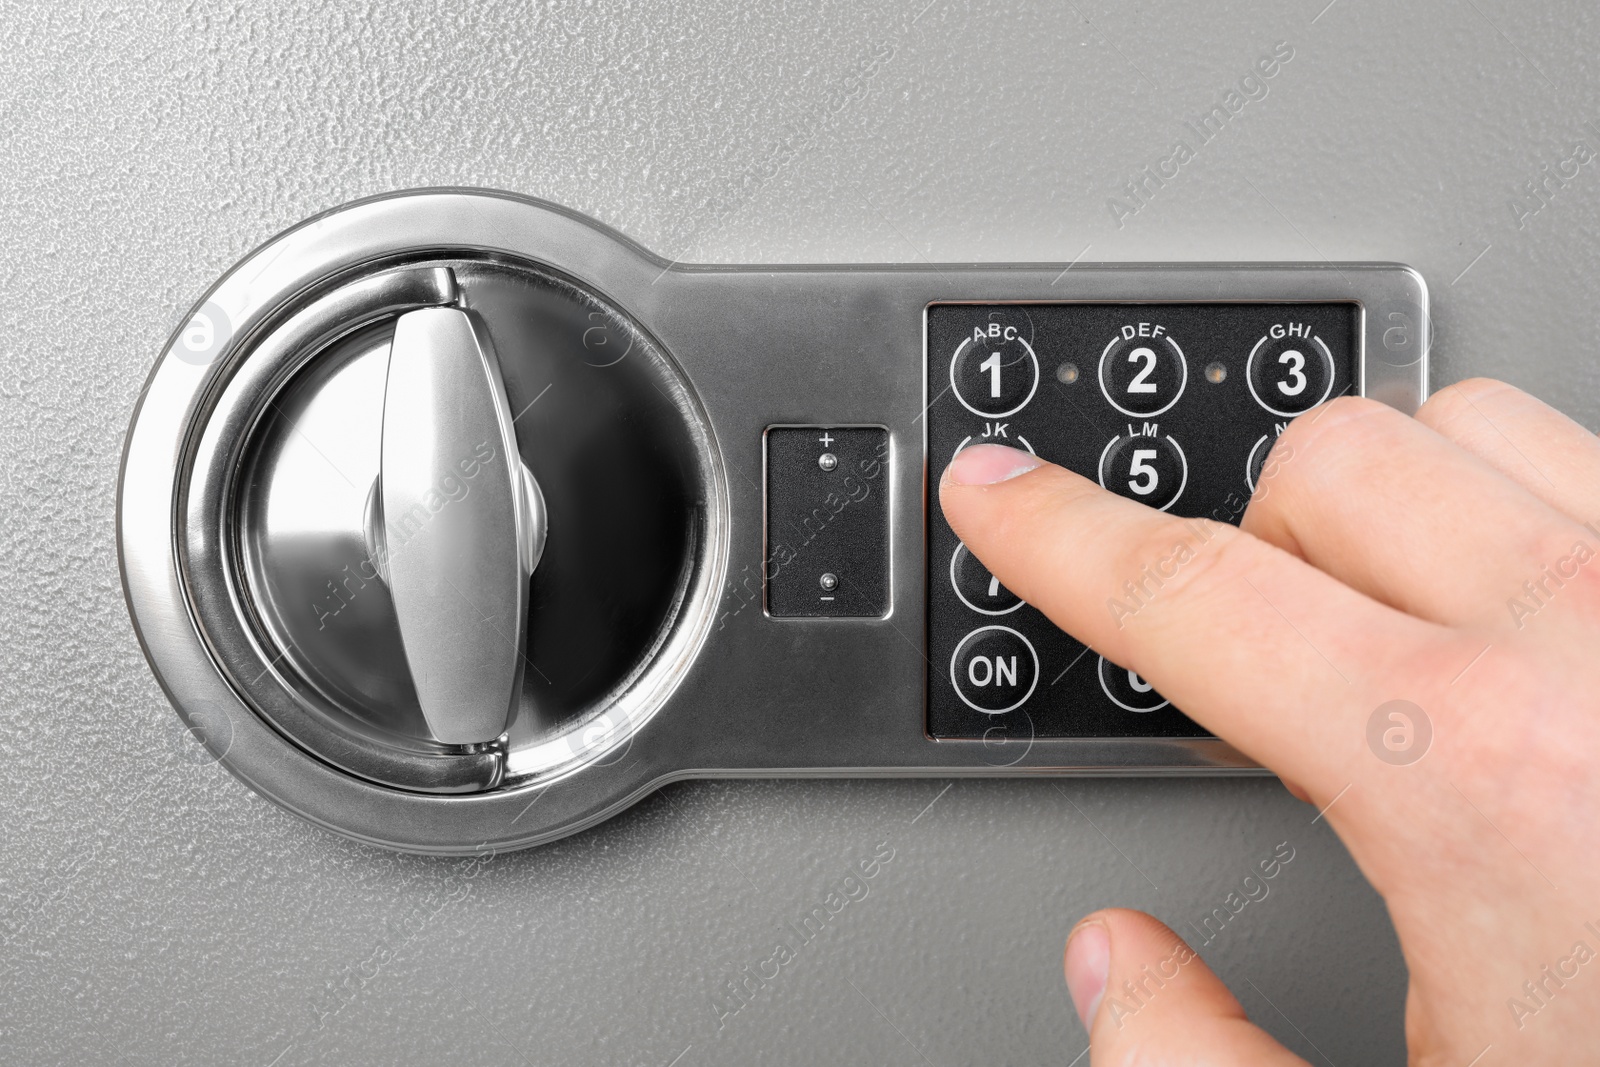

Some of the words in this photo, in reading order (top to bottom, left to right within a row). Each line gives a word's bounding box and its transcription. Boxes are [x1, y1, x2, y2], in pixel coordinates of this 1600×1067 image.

[974, 323, 1018, 342] ABC
[1121, 322, 1166, 340] DEF
[1269, 322, 1312, 339] GHI
[980, 352, 1001, 398] 1
[1127, 347, 1157, 393] 2
[1277, 349, 1307, 396] 3
[981, 422, 1009, 438] JK
[1128, 421, 1158, 438] LM
[1274, 421, 1288, 437] N
[1128, 449, 1159, 495] 5
[968, 655, 1017, 687] ON
